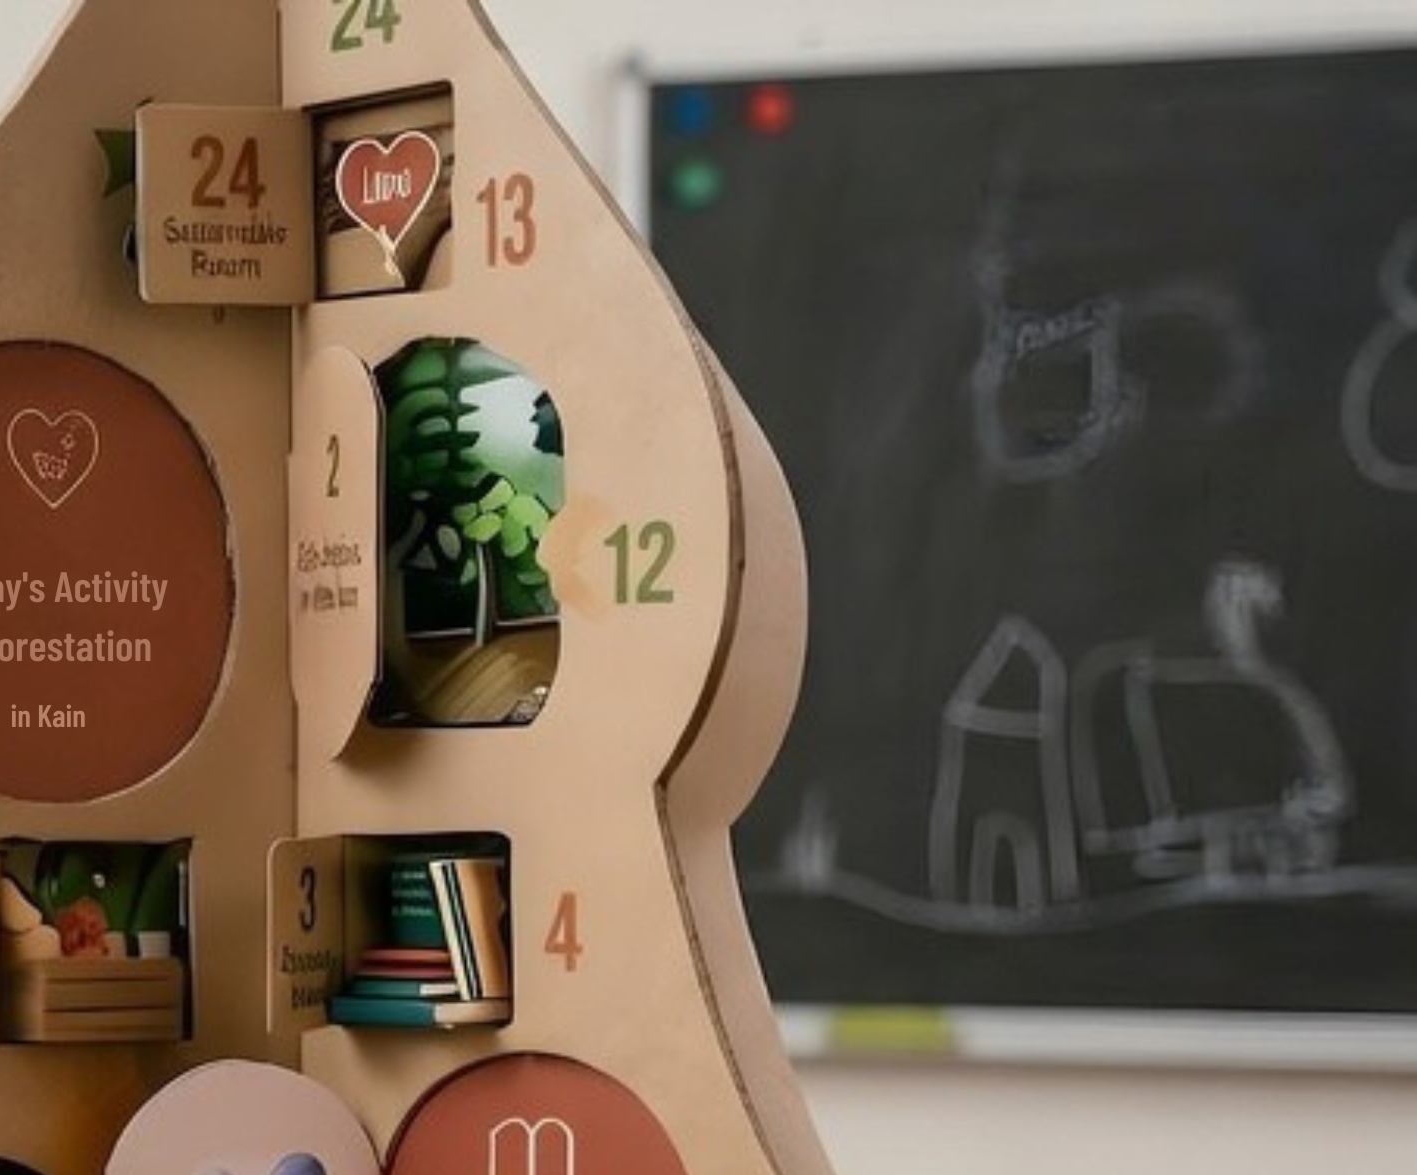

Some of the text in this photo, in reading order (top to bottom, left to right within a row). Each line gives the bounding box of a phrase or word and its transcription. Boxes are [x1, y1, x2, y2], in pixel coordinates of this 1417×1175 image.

[330, 0, 401, 52] 24
[191, 135, 266, 209] 24
[477, 172, 536, 267] 13
[326, 434, 340, 497] 2
[54, 571, 168, 611] Activity
[605, 521, 675, 604] 12
[11, 704, 86, 728] in Kain
[299, 866, 316, 932] 3
[544, 892, 584, 972] 4
